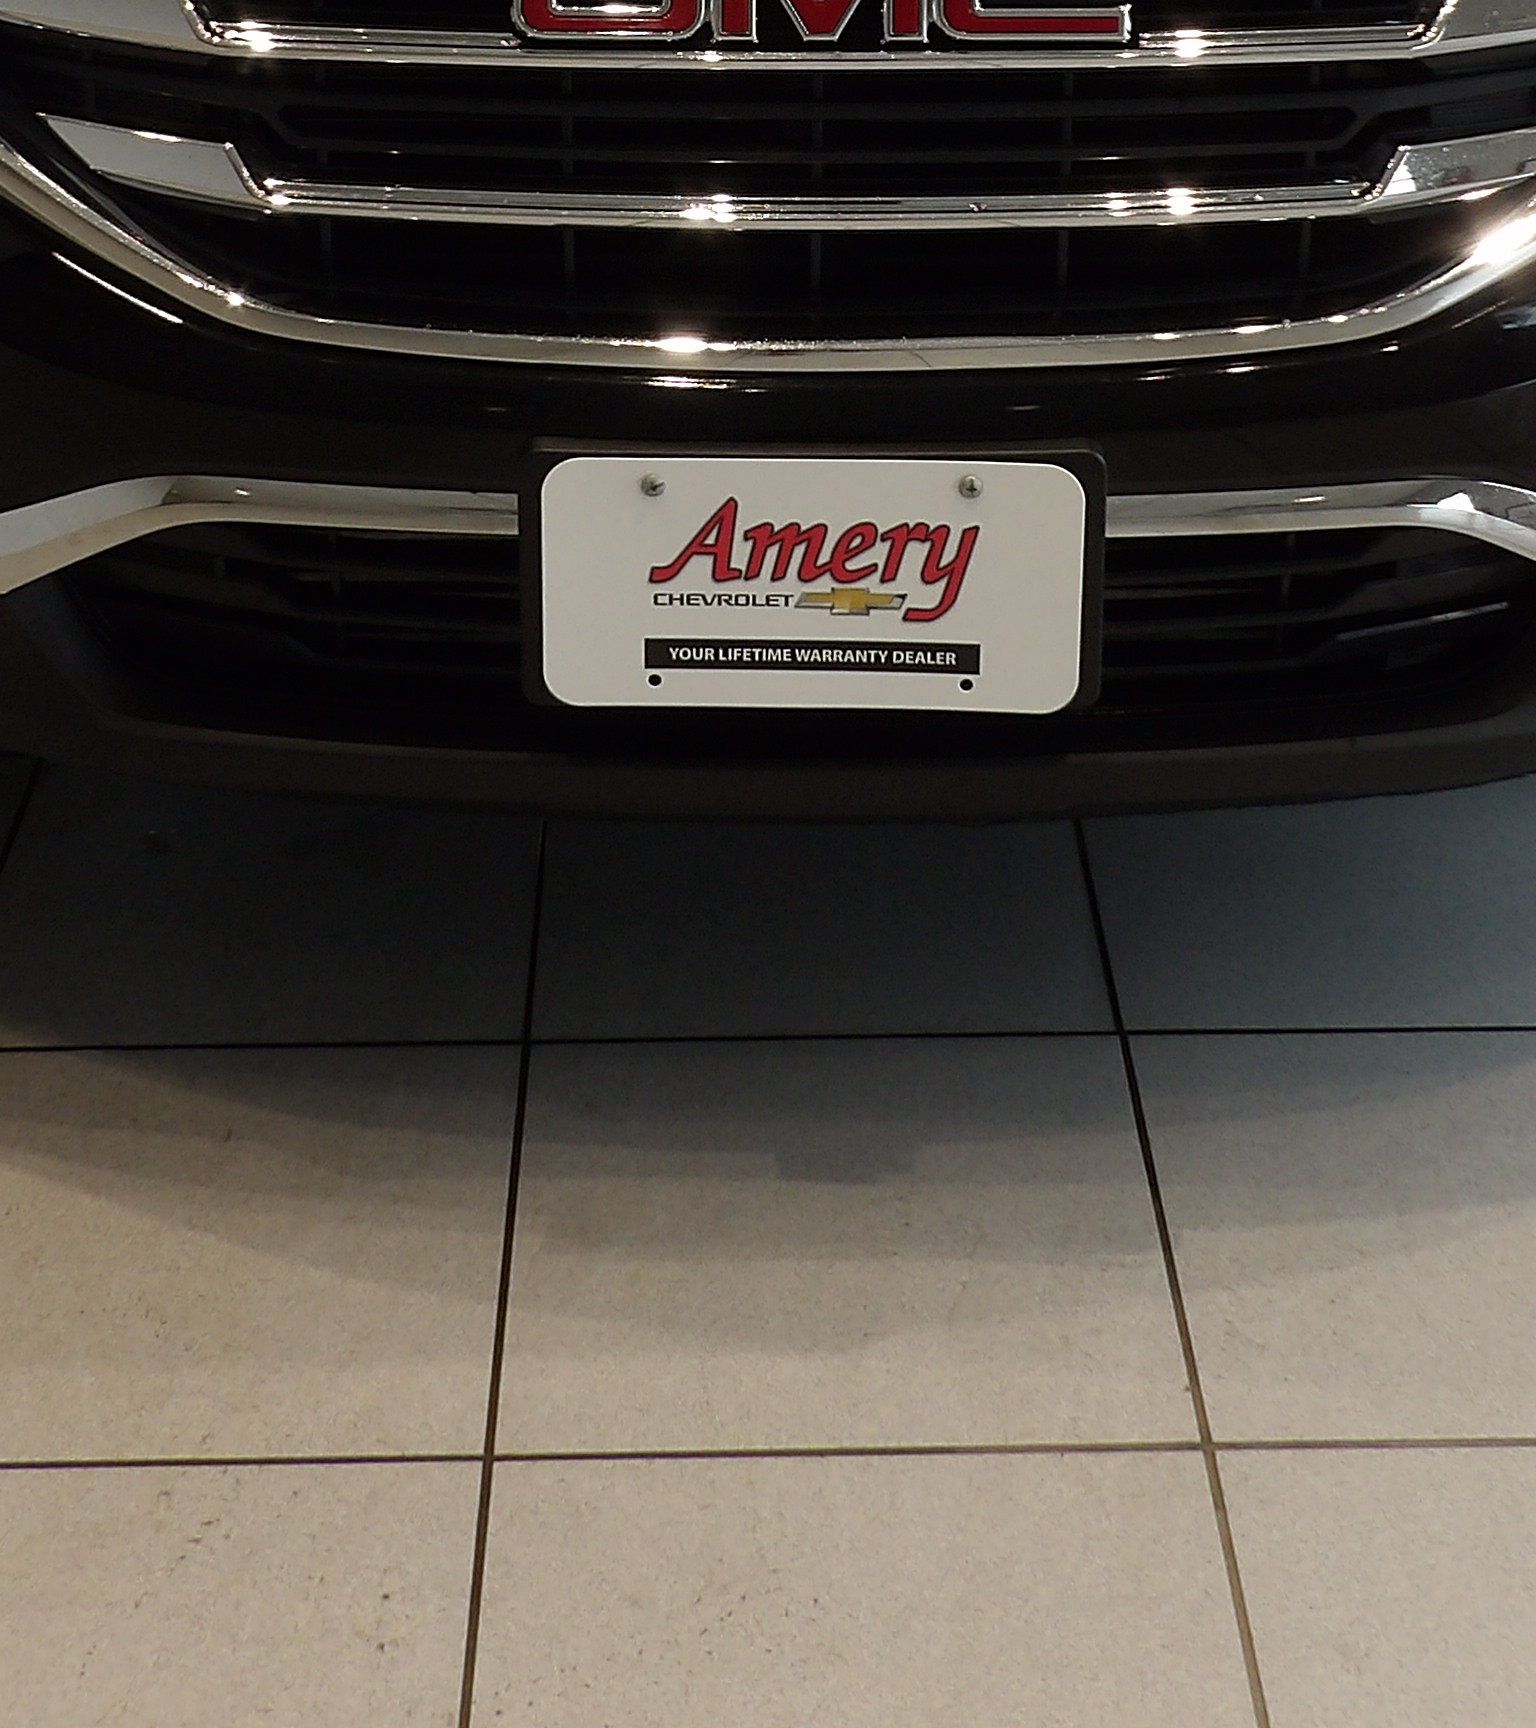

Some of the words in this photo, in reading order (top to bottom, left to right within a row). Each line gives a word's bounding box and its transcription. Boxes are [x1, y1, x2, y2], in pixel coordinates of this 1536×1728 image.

[648, 496, 981, 623] Amery
[652, 592, 795, 608] CHEVROLET
[668, 647, 716, 662] YOUR
[718, 647, 792, 663] LIFETIME
[794, 648, 888, 665] WARRANTY
[892, 650, 957, 666] DEALER
